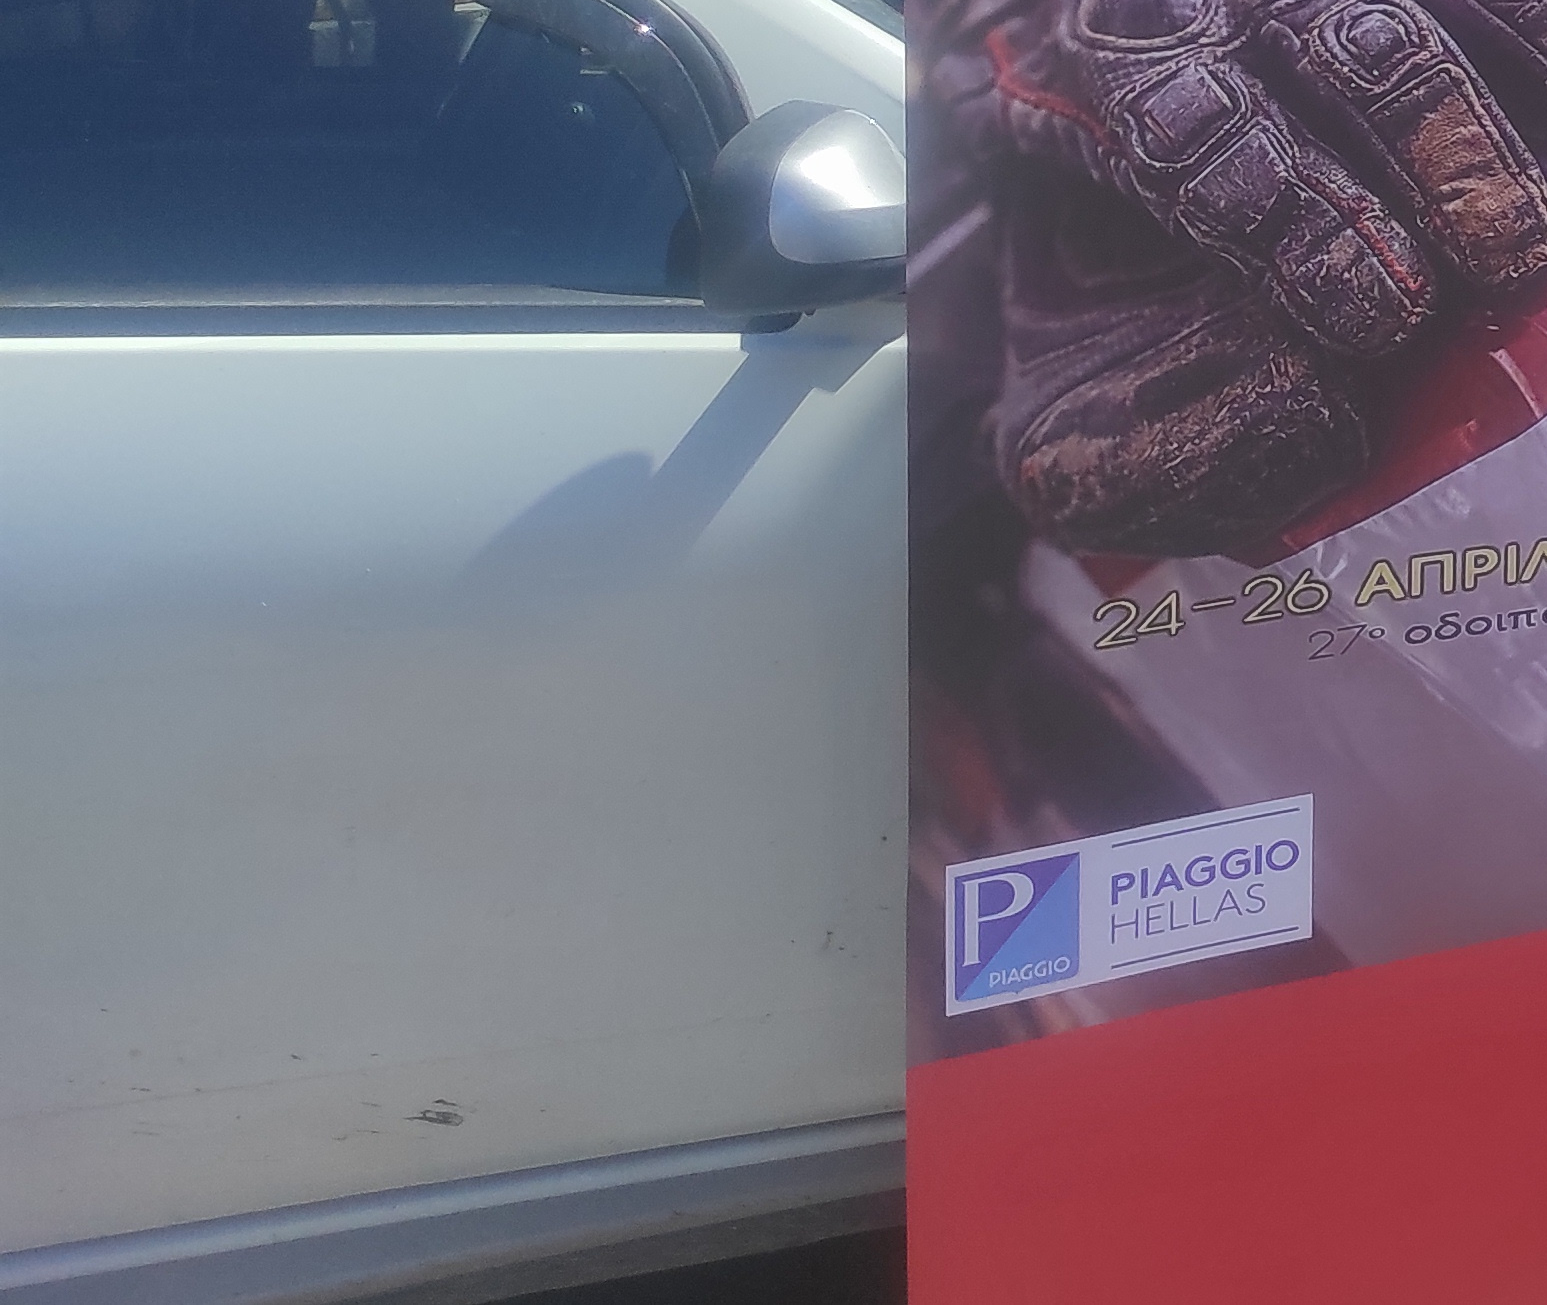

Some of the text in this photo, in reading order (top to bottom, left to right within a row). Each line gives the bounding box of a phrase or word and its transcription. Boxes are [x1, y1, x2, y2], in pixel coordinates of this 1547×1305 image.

[1110, 839, 1301, 906] PIAGGIO
[961, 872, 1035, 968] P
[1111, 882, 1267, 945] HELLAS
[988, 955, 1072, 988] PIAGGIO
